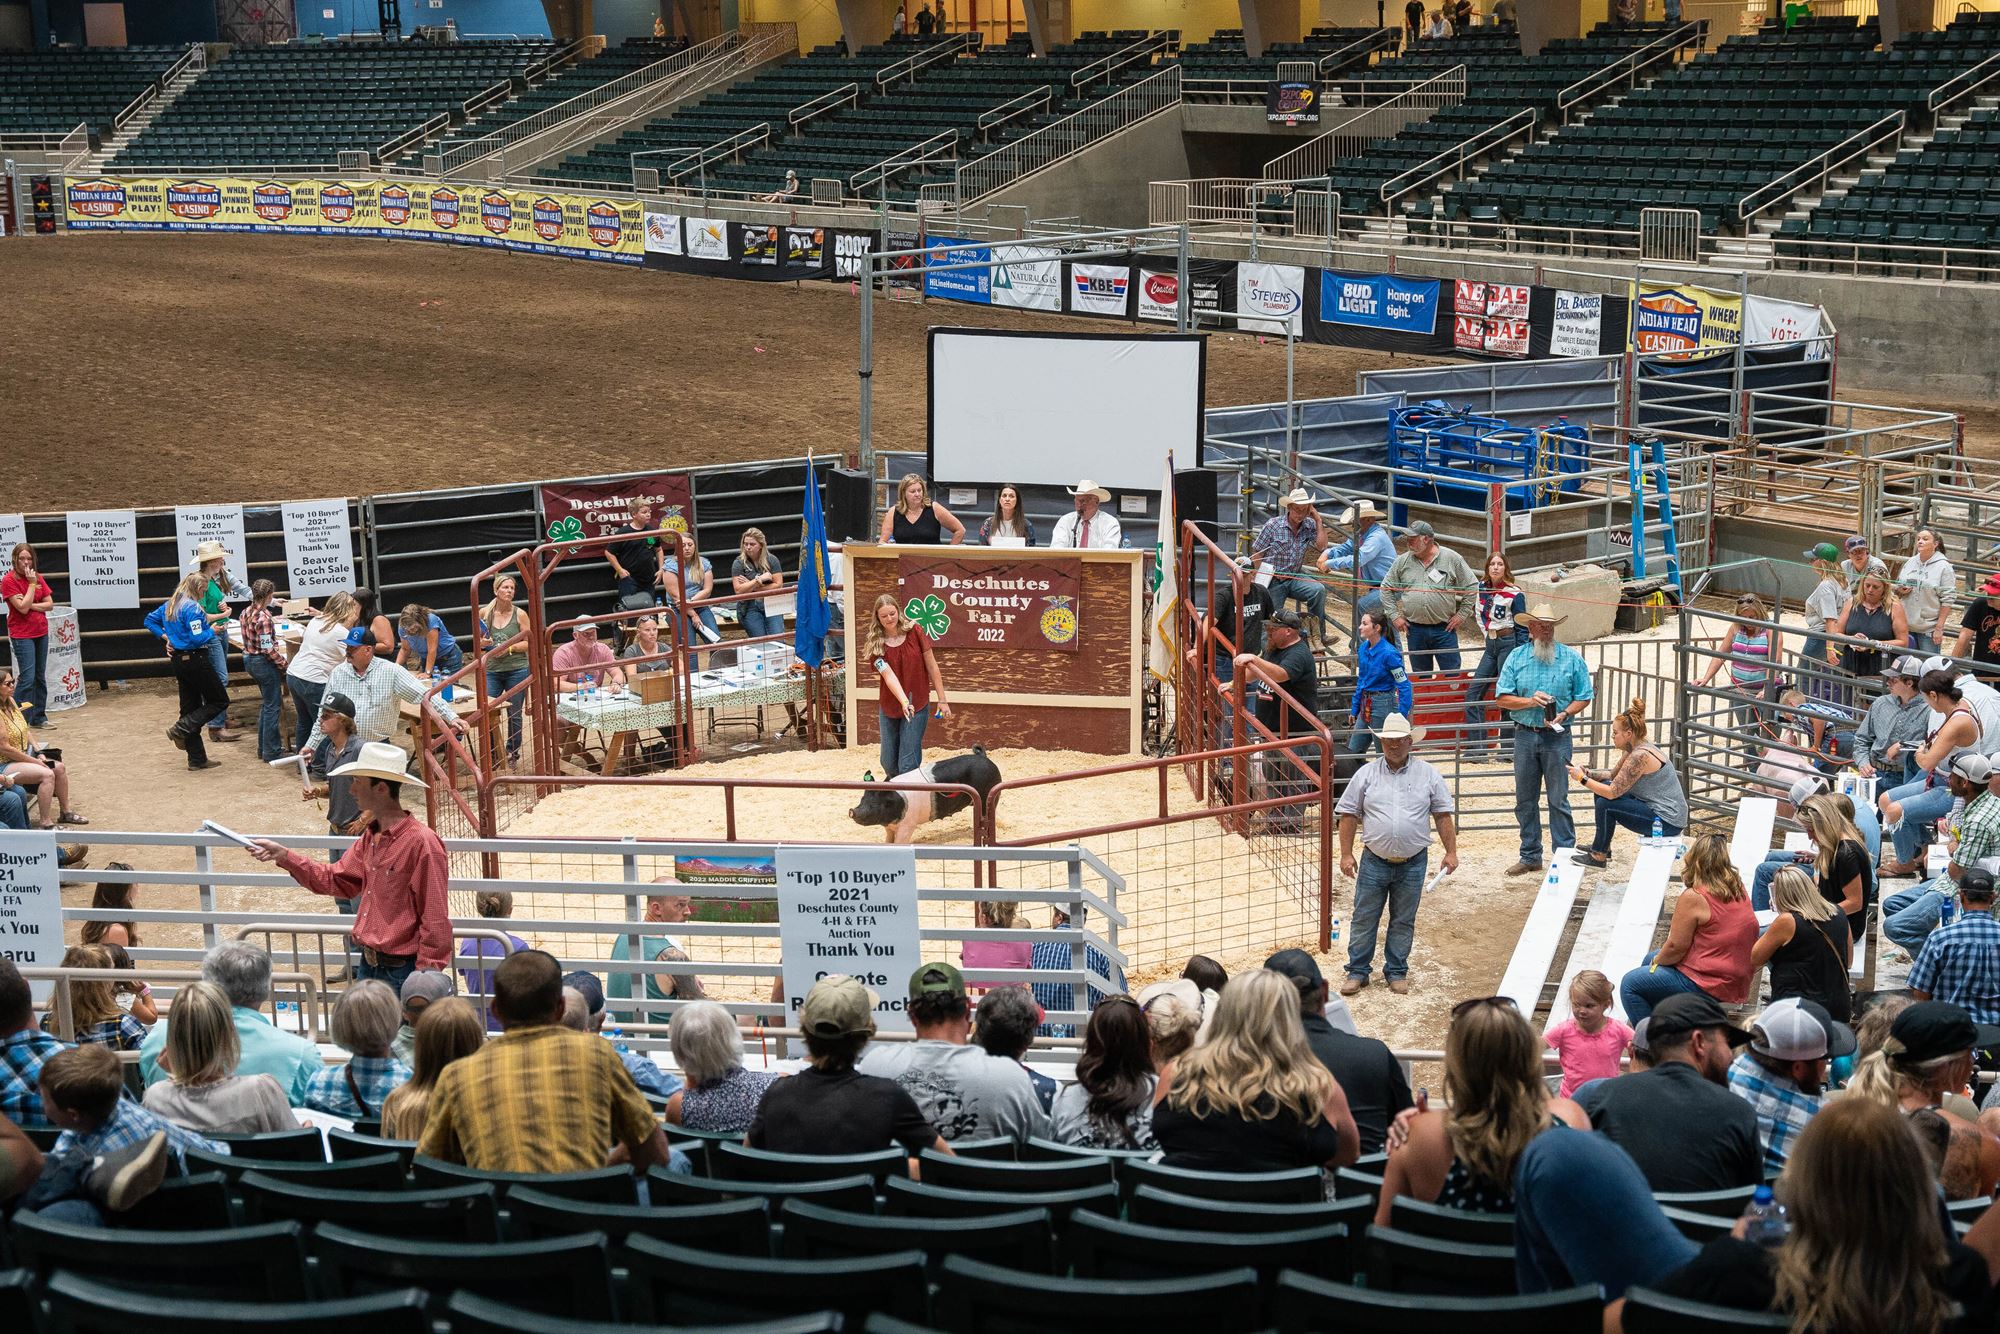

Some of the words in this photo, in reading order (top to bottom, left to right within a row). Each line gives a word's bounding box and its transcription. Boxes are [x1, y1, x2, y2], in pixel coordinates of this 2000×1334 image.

[71, 191, 100, 201] INDIAN
[101, 191, 123, 200] HEAD
[169, 193, 194, 202] INDIAN
[196, 193, 218, 202] HEAD
[222, 196, 250, 204] WINNERS
[255, 196, 273, 204] INDIAN
[274, 196, 289, 204] HEAD
[322, 196, 339, 204] INDIAN
[340, 197, 352, 205] HEAD
[463, 194, 476, 202] WHERE
[292, 198, 316, 206] WINNERS
[381, 197, 396, 206] INDIAN
[396, 198, 407, 207] HEAD
[432, 201, 444, 210] INDIAN
[445, 202, 458, 212] HEAD
[514, 200, 528, 208] WHERE
[82, 203, 114, 212] CASINO
[179, 204, 209, 214] CASINO
[226, 206, 250, 214] PLAY!
[262, 206, 283, 216] CASINO
[460, 205, 478, 214] WINNERS
[482, 203, 497, 214] INDIAN
[497, 206, 510, 216] HEAD
[566, 204, 582, 213] WHERE
[328, 208, 347, 218] CASINO
[387, 210, 404, 219] CASINO
[412, 212, 428, 220] PLAY!
[512, 211, 530, 220] WINNERS
[535, 210, 550, 221] INDIAN
[550, 213, 562, 223] HEAD
[623, 210, 640, 218] WHERE
[437, 213, 454, 224] CASINO
[462, 216, 478, 225] PLAY!
[487, 217, 506, 229] CASINO
[563, 216, 584, 225] WINNERS
[588, 215, 605, 226] INDIAN
[606, 217, 619, 228] HEAD
[514, 222, 530, 231] PLAY!
[540, 224, 558, 235] CASINO
[621, 221, 642, 231] WINNERS
[566, 227, 584, 237] PLAY!
[594, 230, 613, 241] CASINO
[623, 233, 642, 243] PLAY!
[835, 235, 871, 257] BOOT
[836, 257, 861, 277] BAR
[1011, 271, 1040, 281] NATURAL
[1042, 274, 1056, 284] GAS
[930, 278, 975, 292] HiLineHomes.com
[1089, 278, 1113, 292] KBE
[1151, 282, 1175, 294] Coastal
[1252, 289, 1291, 303] STEVENS
[1344, 283, 1372, 299] BUD
[1387, 288, 1410, 304] Hang
[1412, 294, 1424, 303] on
[1263, 302, 1289, 310] PLUMBING
[1339, 297, 1377, 314] LIGHT
[1557, 298, 1569, 309] DEL
[1573, 297, 1600, 309] BARBER
[1387, 305, 1410, 319] tight.
[1556, 311, 1587, 320] EXCAVATION,
[1710, 306, 1738, 324] WHERE
[1639, 312, 1670, 328] NDIAN
[1672, 316, 1698, 334] HEAD
[1566, 326, 1574, 334] Dig
[1702, 324, 1740, 344] WINNERS
[1646, 335, 1684, 350] CASINO
[585, 512, 633, 523] Coun
[297, 544, 322, 552] Thank
[303, 556, 338, 565] Beaver
[294, 566, 325, 576] Coach
[328, 564, 349, 573] Sale
[75, 578, 135, 586] Construction
[299, 578, 306, 586] &
[310, 575, 346, 585] Service
[932, 574, 1050, 590] Deschutes
[949, 592, 1032, 611] County
[967, 610, 1016, 624] Fair
[978, 628, 1005, 642] 2022
[829, 871, 848, 883] 10
[6, 885, 42, 895] County
[829, 888, 869, 900] 2021
[4, 896, 22, 905] FFA
[798, 904, 856, 913] Deschutes
[860, 903, 898, 914] County
[822, 916, 840, 926] 4-H
[845, 916, 852, 925] &
[857, 916, 876, 925] FFA
[10, 922, 39, 935] You
[828, 929, 870, 938] Auction
[806, 942, 858, 957] Thank
[863, 942, 895, 957] You
